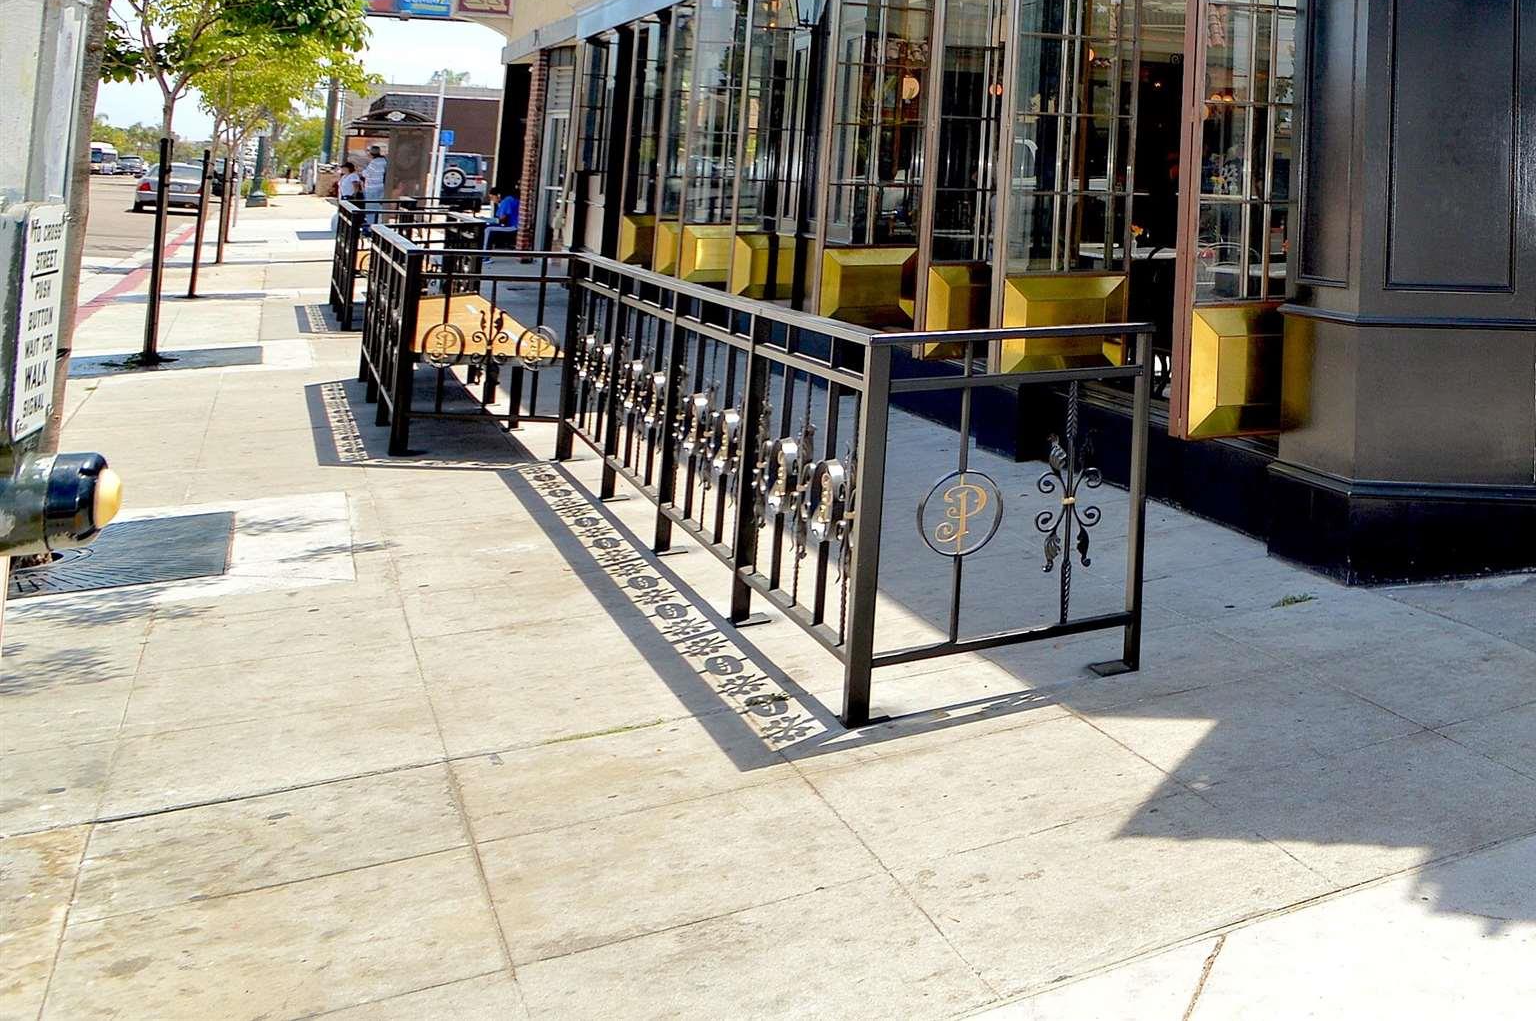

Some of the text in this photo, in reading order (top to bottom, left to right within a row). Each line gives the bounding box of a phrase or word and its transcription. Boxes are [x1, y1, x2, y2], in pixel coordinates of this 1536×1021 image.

[43, 223, 61, 242] CROSS
[36, 249, 58, 270] STREET
[34, 279, 52, 300] PUSH
[28, 307, 53, 331] BUTTON
[24, 333, 53, 360] WAIT FOR
[24, 359, 49, 393] WALK
[22, 393, 44, 419] SIGNAL
